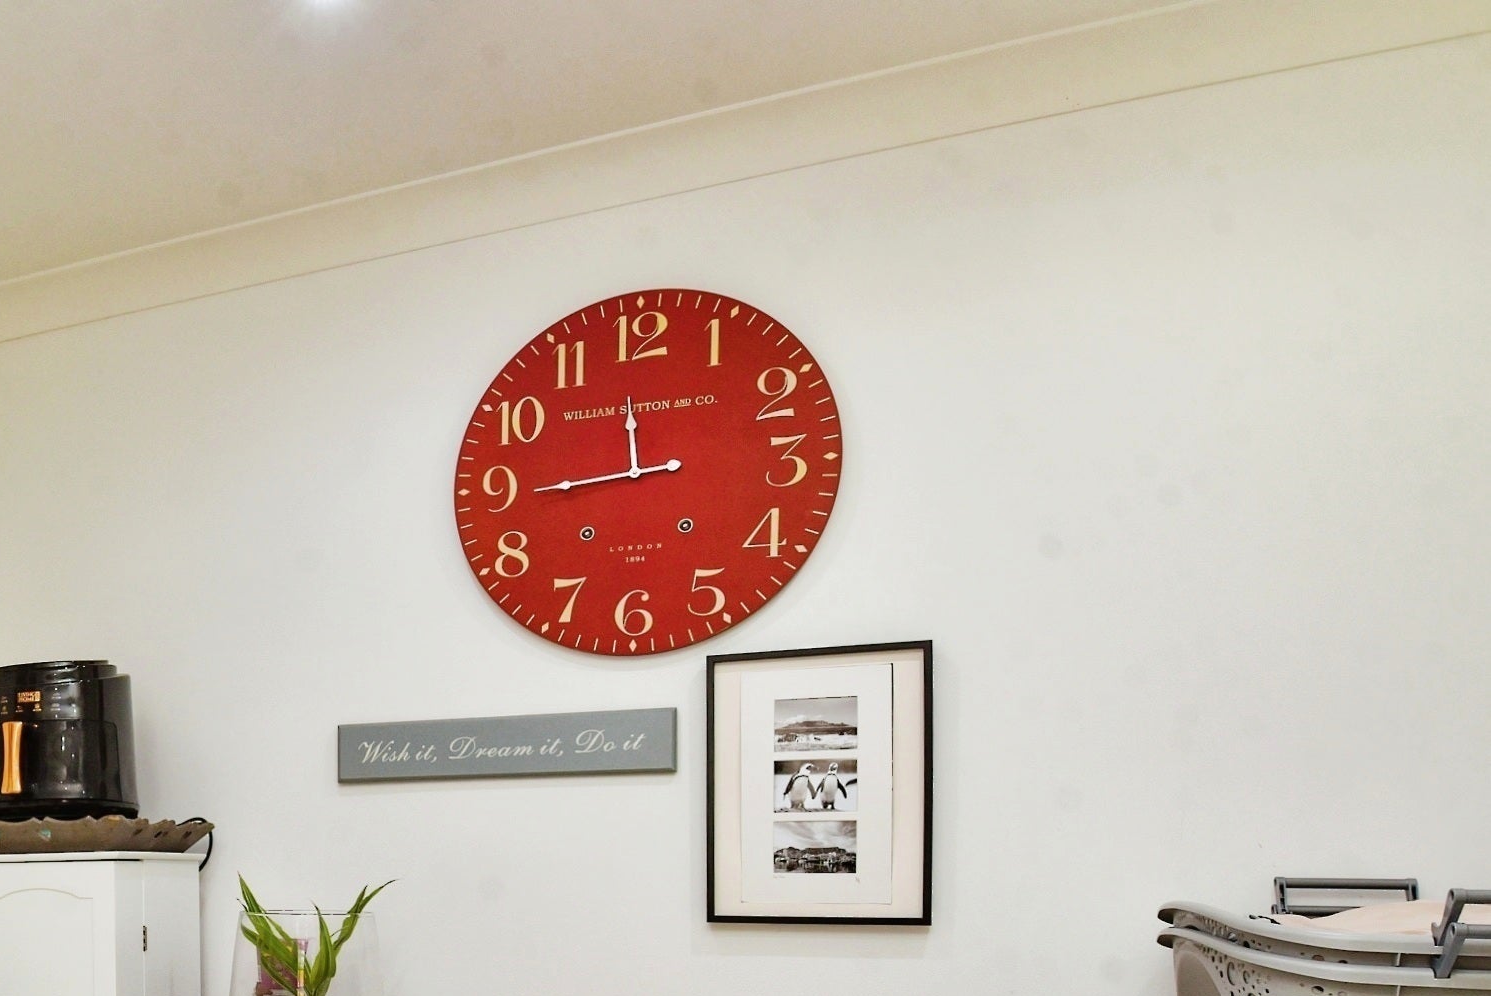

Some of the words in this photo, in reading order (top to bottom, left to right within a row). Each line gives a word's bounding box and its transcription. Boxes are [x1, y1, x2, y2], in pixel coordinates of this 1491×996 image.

[613, 311, 668, 363] 12
[704, 318, 722, 367] 1
[552, 340, 586, 390] 11
[563, 406, 615, 421] WILLIAM
[619, 399, 671, 415] SUTTON
[674, 397, 691, 407] AND
[695, 395, 718, 406] CO.
[756, 366, 797, 420] 2
[496, 396, 545, 446] 10
[765, 433, 807, 487] 3
[482, 465, 518, 513] 9
[494, 531, 530, 578] 8
[609, 542, 663, 552] LONDON
[741, 507, 787, 558] 4
[625, 555, 645, 563] 1894
[553, 577, 587, 623] 7
[614, 589, 653, 636] 6
[687, 567, 726, 616] 5
[359, 741, 410, 764] Wish
[415, 742, 438, 763] it,
[448, 736, 534, 760] Dream
[540, 738, 564, 757] it,
[575, 729, 616, 753] Do
[623, 731, 646, 751] it
